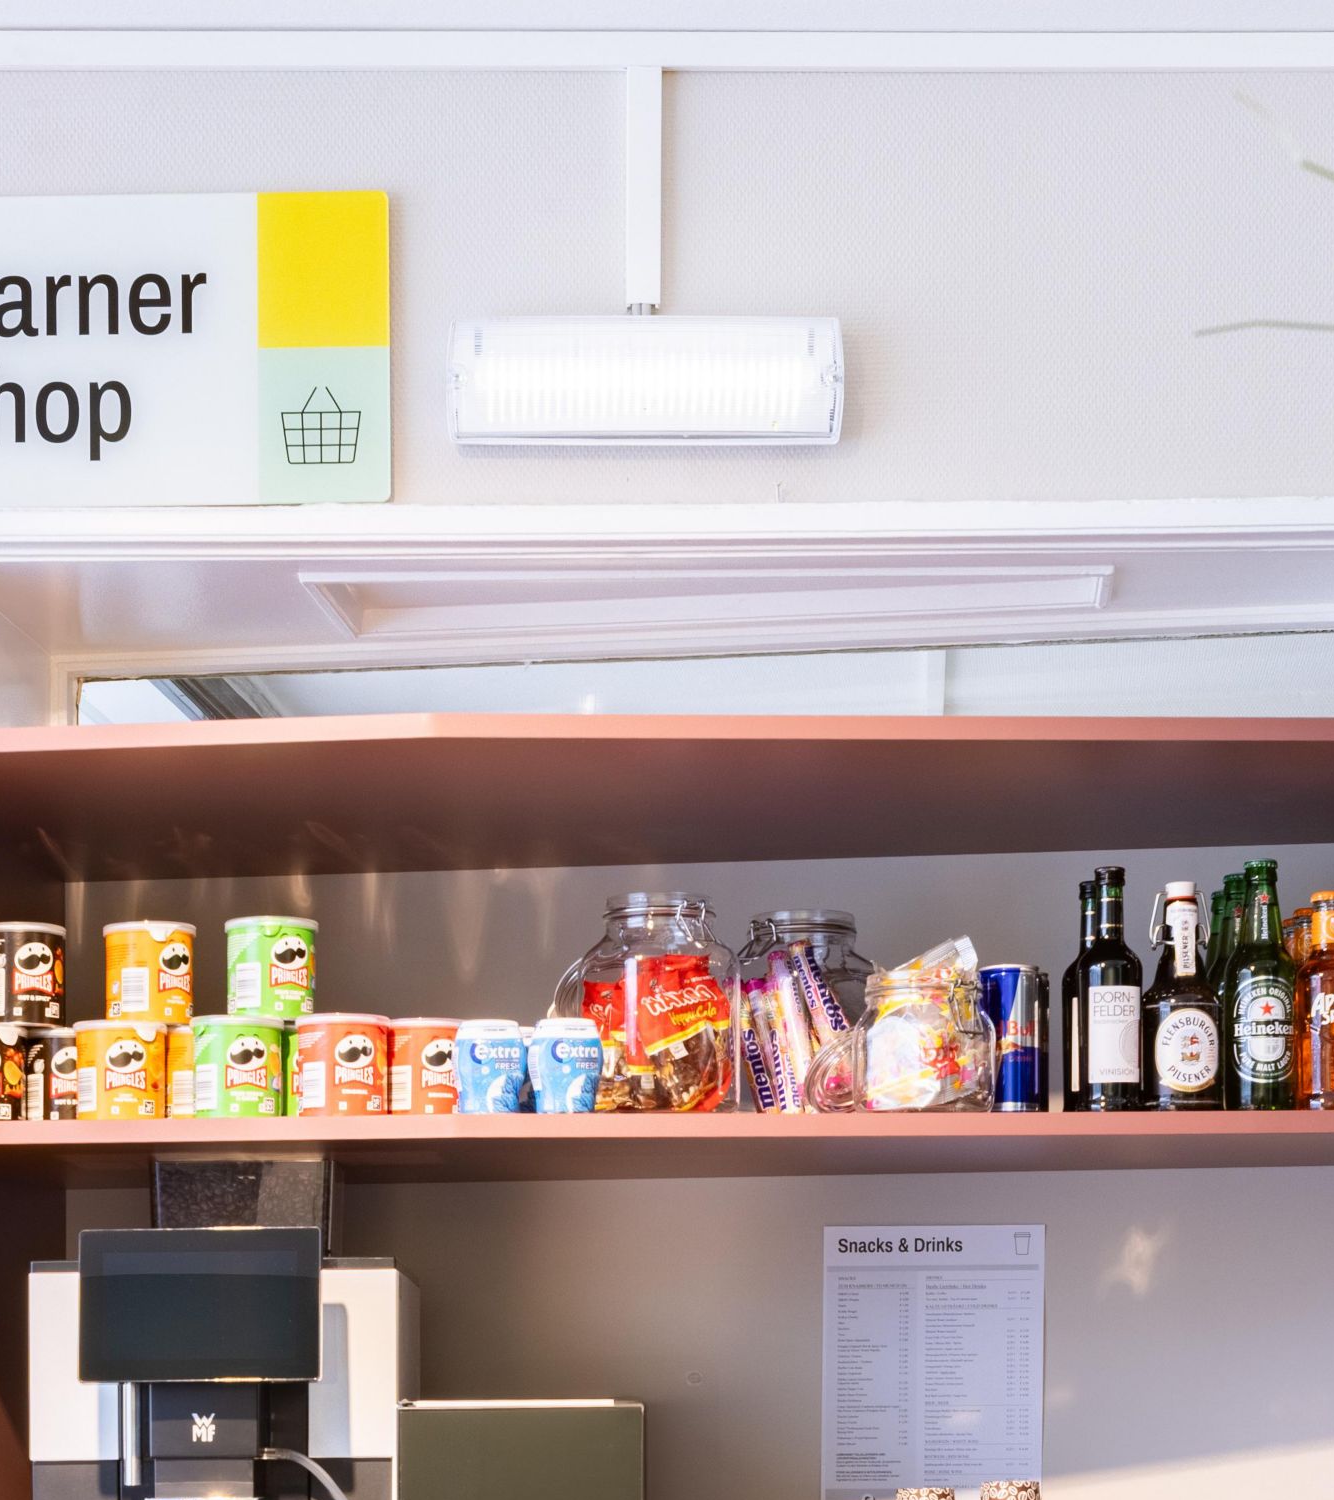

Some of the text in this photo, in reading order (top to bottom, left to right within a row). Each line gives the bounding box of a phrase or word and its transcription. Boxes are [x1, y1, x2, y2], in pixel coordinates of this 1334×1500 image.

[1261, 904, 1269, 940] Heineken
[14, 971, 53, 994] PRINGLES
[159, 971, 190, 993] PRINGLES
[271, 966, 308, 988] PRINGLES
[793, 955, 817, 1009] mentos
[1093, 991, 1135, 1004] DORN-
[1093, 1005, 1136, 1017] FELDER
[1162, 1016, 1215, 1047] FLENSBURGER
[1234, 1022, 1295, 1037] Heineken
[474, 1043, 520, 1060] extra
[555, 1042, 598, 1059] extra
[495, 1062, 520, 1070] FRESH
[575, 1061, 599, 1070] FRESH
[743, 1028, 775, 1109] mentos
[1168, 1064, 1212, 1083] PILSENER
[1255, 1063, 1275, 1072] MALT
[106, 1069, 146, 1091] PRINGLES
[227, 1066, 267, 1088] PRINGLES
[335, 1066, 374, 1085] PRINGLES
[837, 1237, 963, 1253] Snacks & Drinks
